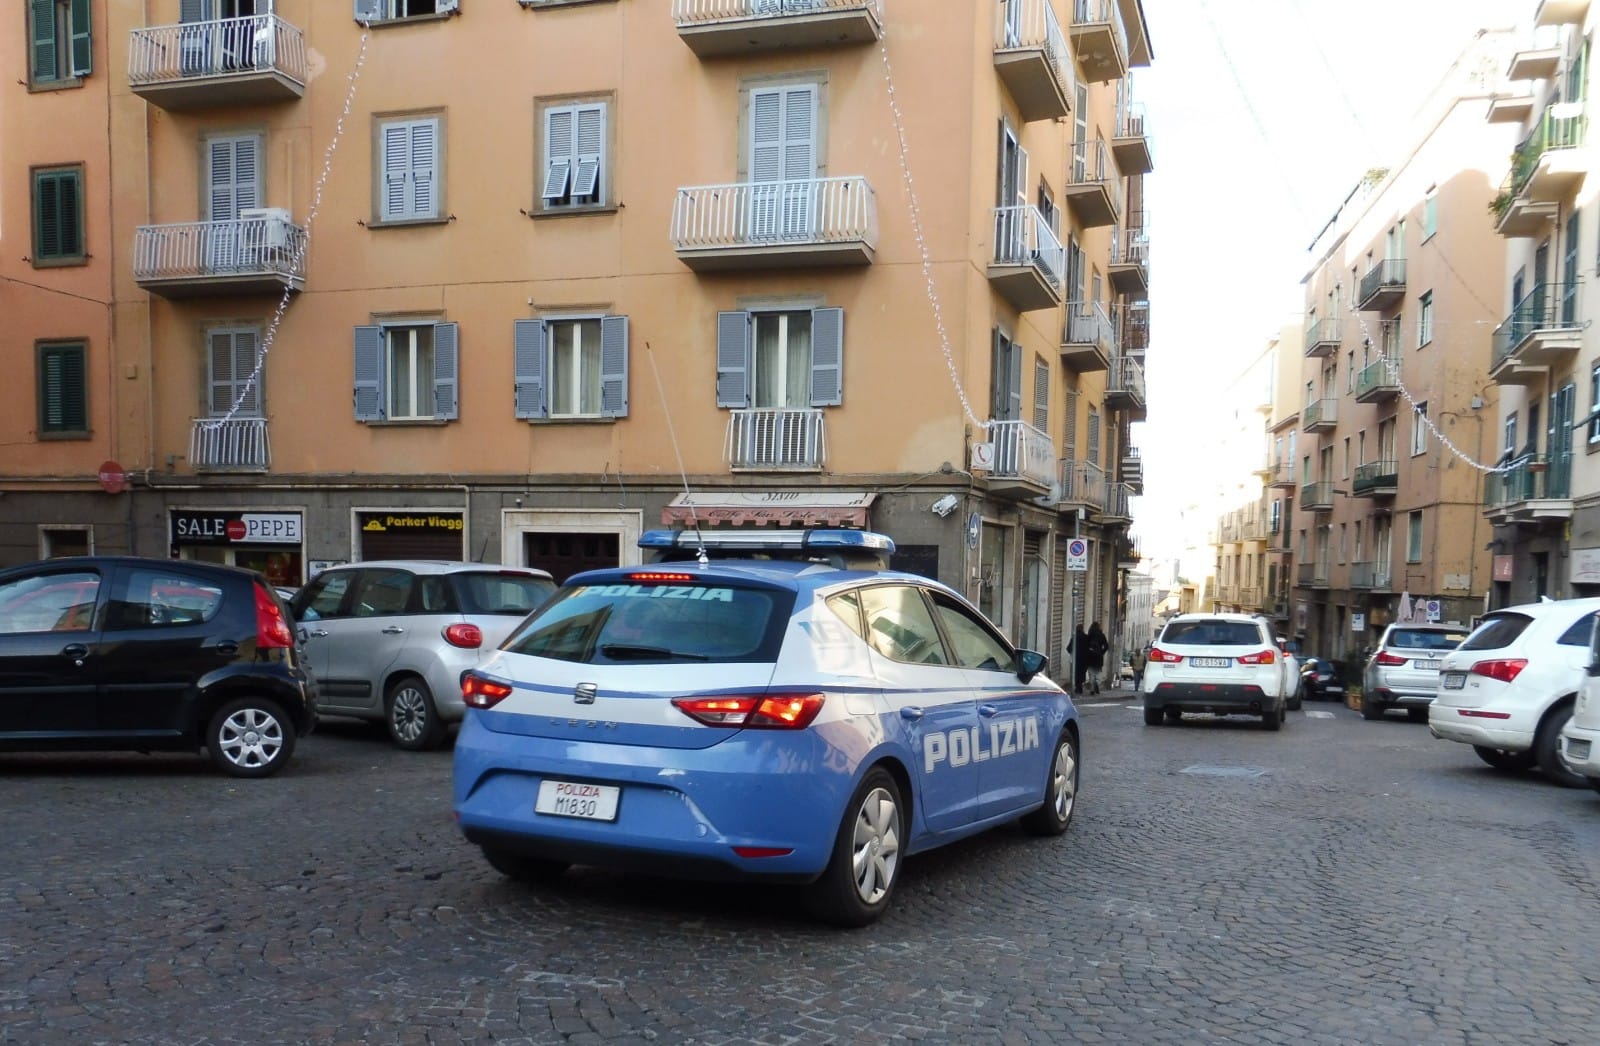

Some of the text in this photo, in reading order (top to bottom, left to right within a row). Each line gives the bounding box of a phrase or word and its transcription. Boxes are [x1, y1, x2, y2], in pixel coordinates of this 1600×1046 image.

[177, 518, 296, 537] SALE PEPE
[386, 515, 426, 527] Parker
[579, 585, 733, 602] POLIZIA
[923, 715, 1039, 774] POLIZIA
[556, 783, 600, 798] POLIZIA
